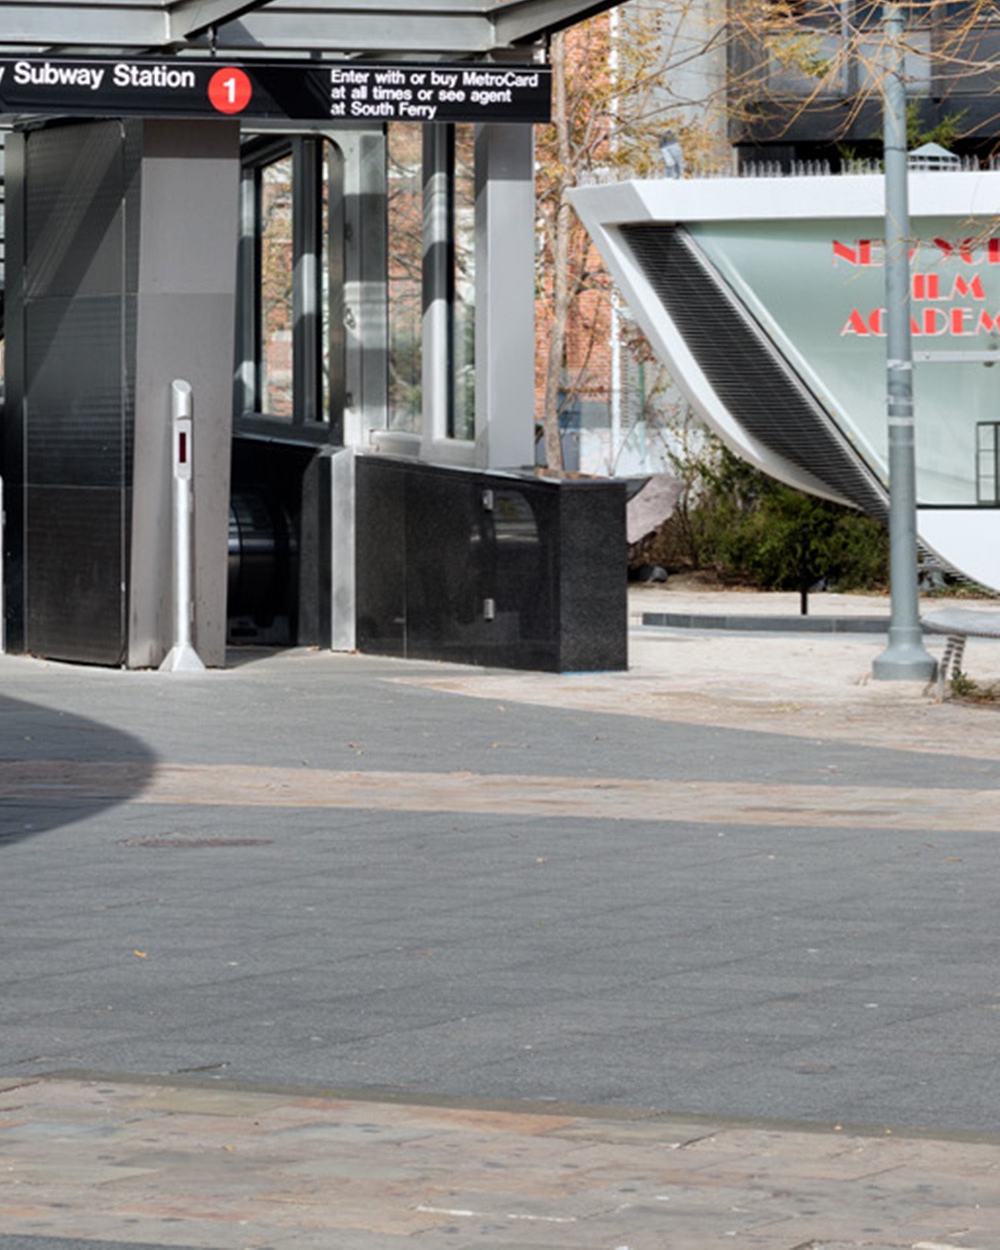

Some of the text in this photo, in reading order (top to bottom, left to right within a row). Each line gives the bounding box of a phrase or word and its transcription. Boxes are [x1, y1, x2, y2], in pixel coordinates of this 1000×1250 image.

[13, 61, 104, 89] Subway
[113, 63, 195, 88] Station
[331, 69, 538, 88] Enter with or buy MetroCard
[222, 77, 237, 104] 1
[331, 86, 512, 105] at all times or see agent
[331, 101, 437, 119] at South Ferry
[911, 273, 986, 301] ILM
